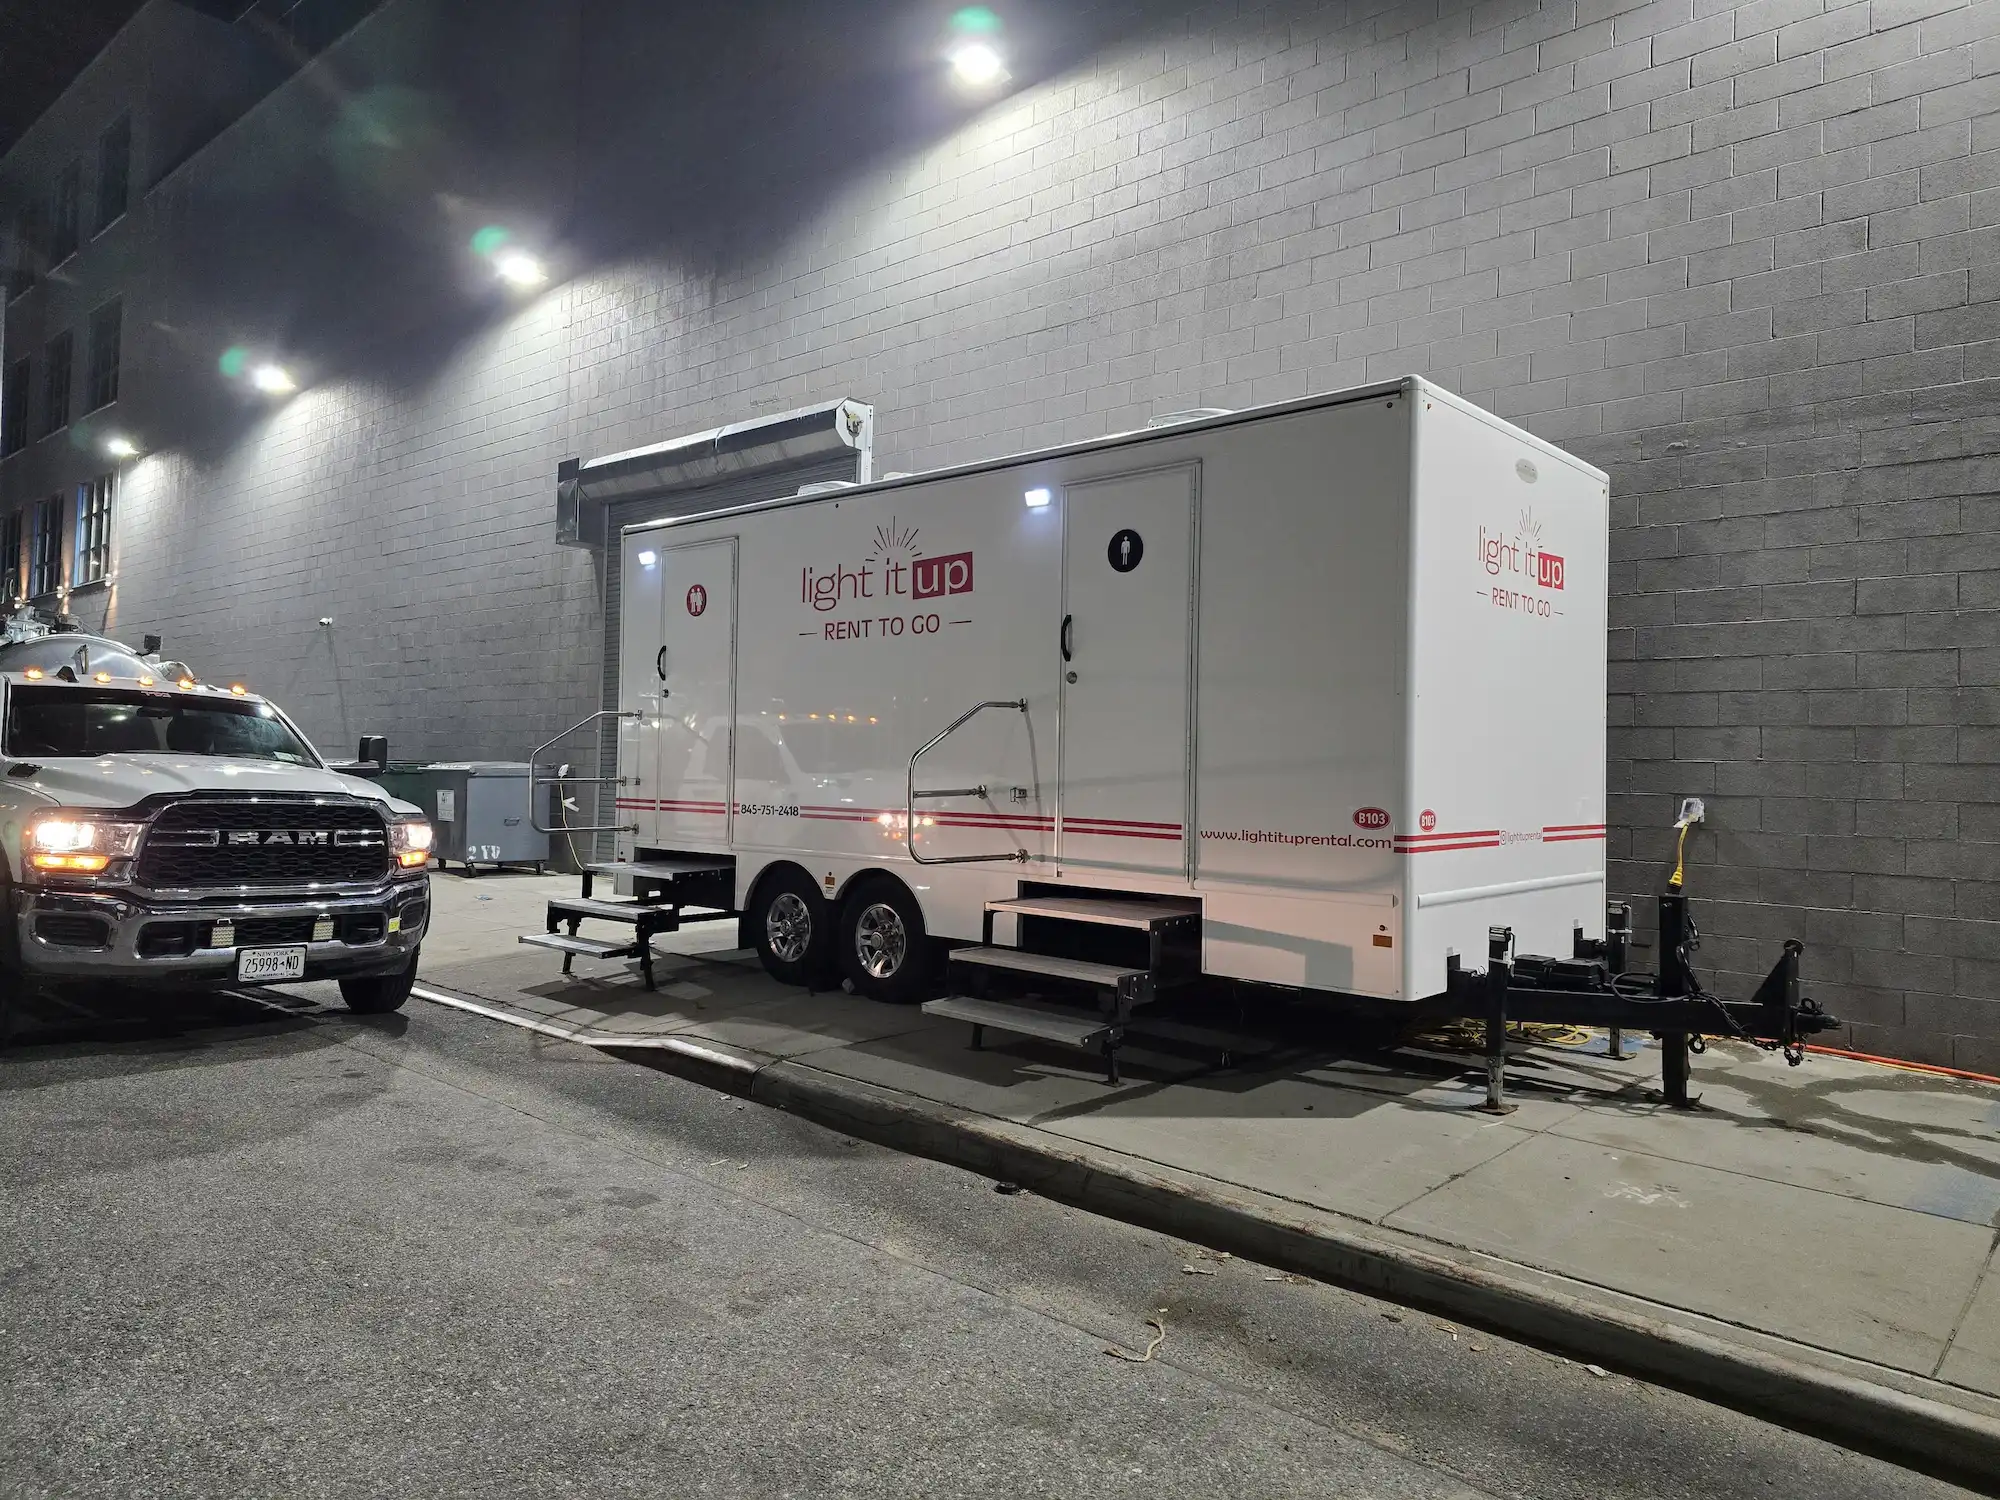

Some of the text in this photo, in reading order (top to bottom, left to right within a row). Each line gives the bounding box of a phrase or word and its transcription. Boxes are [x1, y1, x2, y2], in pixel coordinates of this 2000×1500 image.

[1478, 525, 1563, 589] light it up
[801, 557, 970, 611] light it up
[1492, 587, 1550, 617] RENT TO GO
[824, 614, 940, 640] RENT TO GO
[741, 804, 799, 816] 845-751-2418
[1358, 812, 1386, 825] B103
[1421, 814, 1435, 827] B103
[228, 832, 329, 845] RAM
[1200, 829, 1392, 849] www.lightituprental.com
[467, 845, 477, 862] 2
